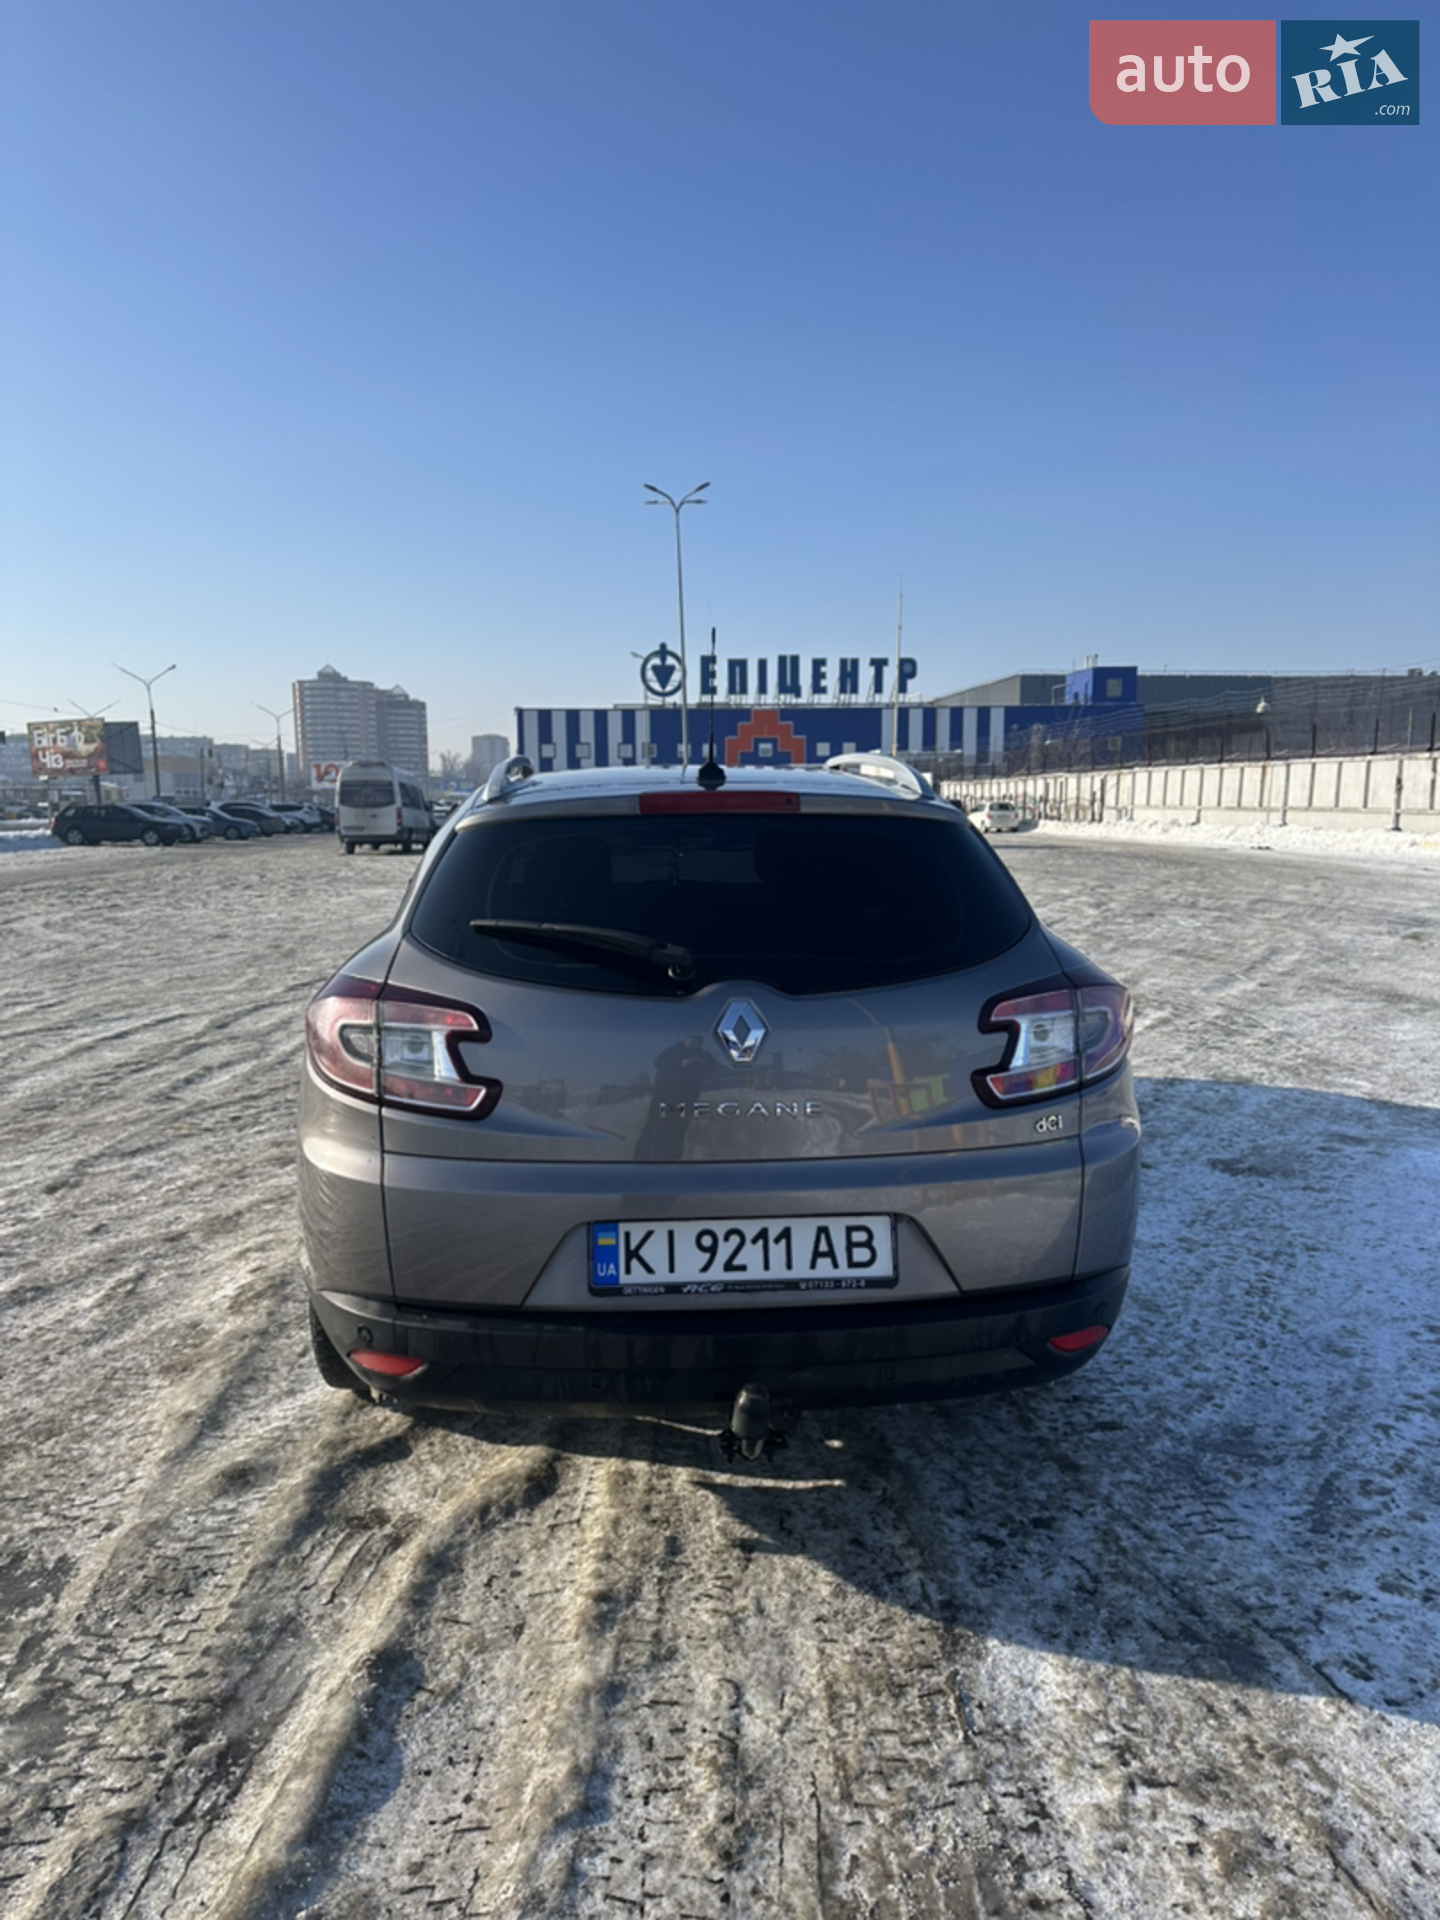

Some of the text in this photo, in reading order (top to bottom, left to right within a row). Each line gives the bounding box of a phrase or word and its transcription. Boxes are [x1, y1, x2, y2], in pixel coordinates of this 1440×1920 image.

[700, 654, 917, 698] ЕПІЦЕНТР
[659, 1102, 823, 1119] MEGANE
[623, 1225, 878, 1275] KI 9211 AB
[597, 1262, 617, 1277] UA
